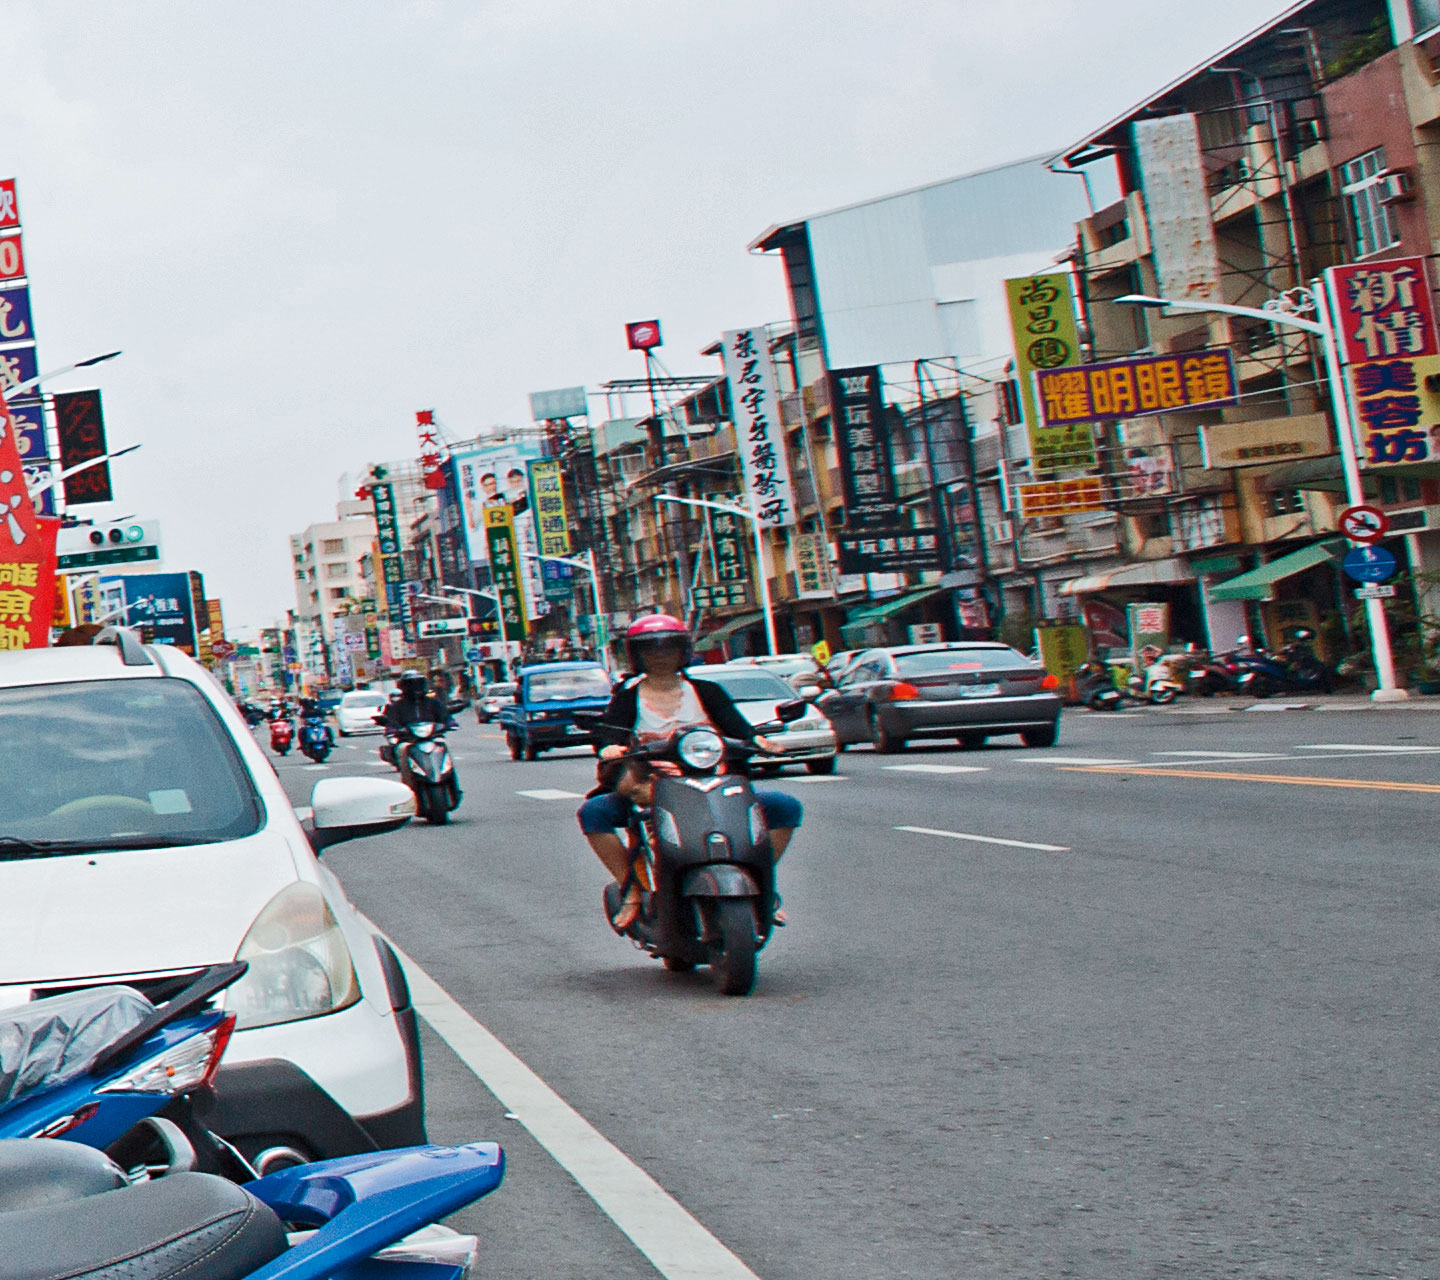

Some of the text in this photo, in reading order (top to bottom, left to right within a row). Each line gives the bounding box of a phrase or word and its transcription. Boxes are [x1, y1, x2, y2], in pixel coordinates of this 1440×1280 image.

[1346, 265, 1425, 360] 新情
[1041, 354, 1232, 421] 耀明眼鏡
[1353, 360, 1430, 465] 美容坊
